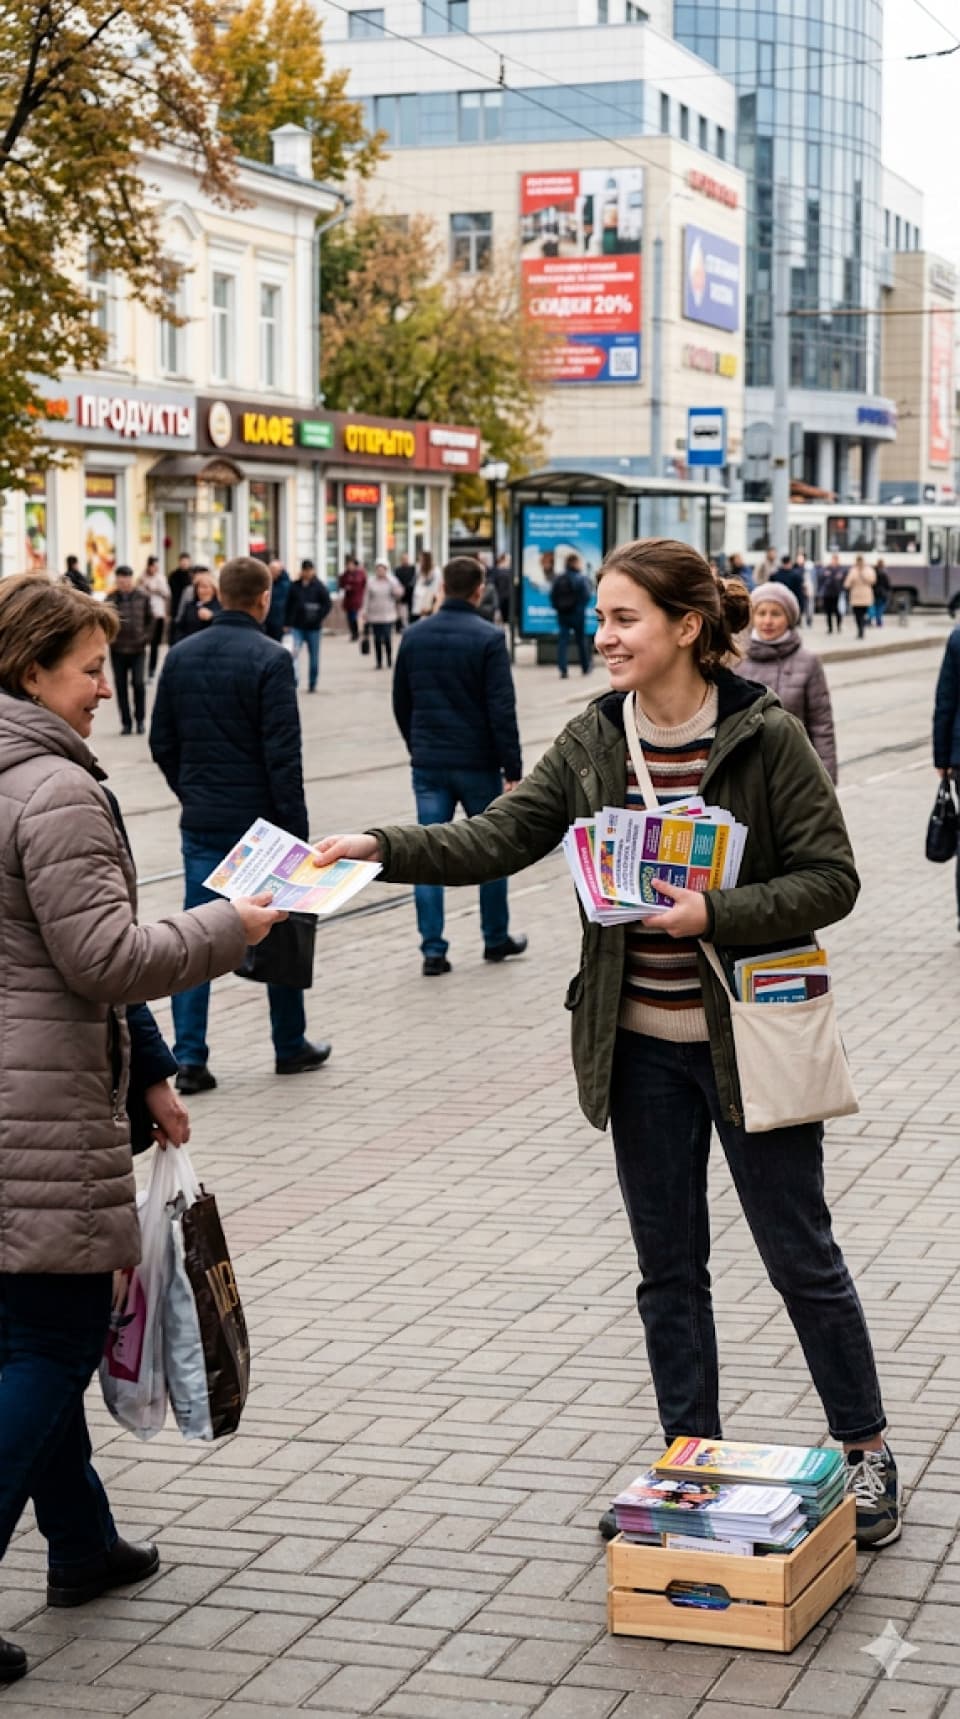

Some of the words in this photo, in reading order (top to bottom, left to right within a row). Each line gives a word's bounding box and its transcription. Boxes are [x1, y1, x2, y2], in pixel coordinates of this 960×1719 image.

[594, 294, 633, 315] 20%
[78, 395, 191, 438] ПРОДУКТЫ
[243, 412, 295, 447] КАФЕ
[345, 424, 415, 459] ОТКРЫТО
